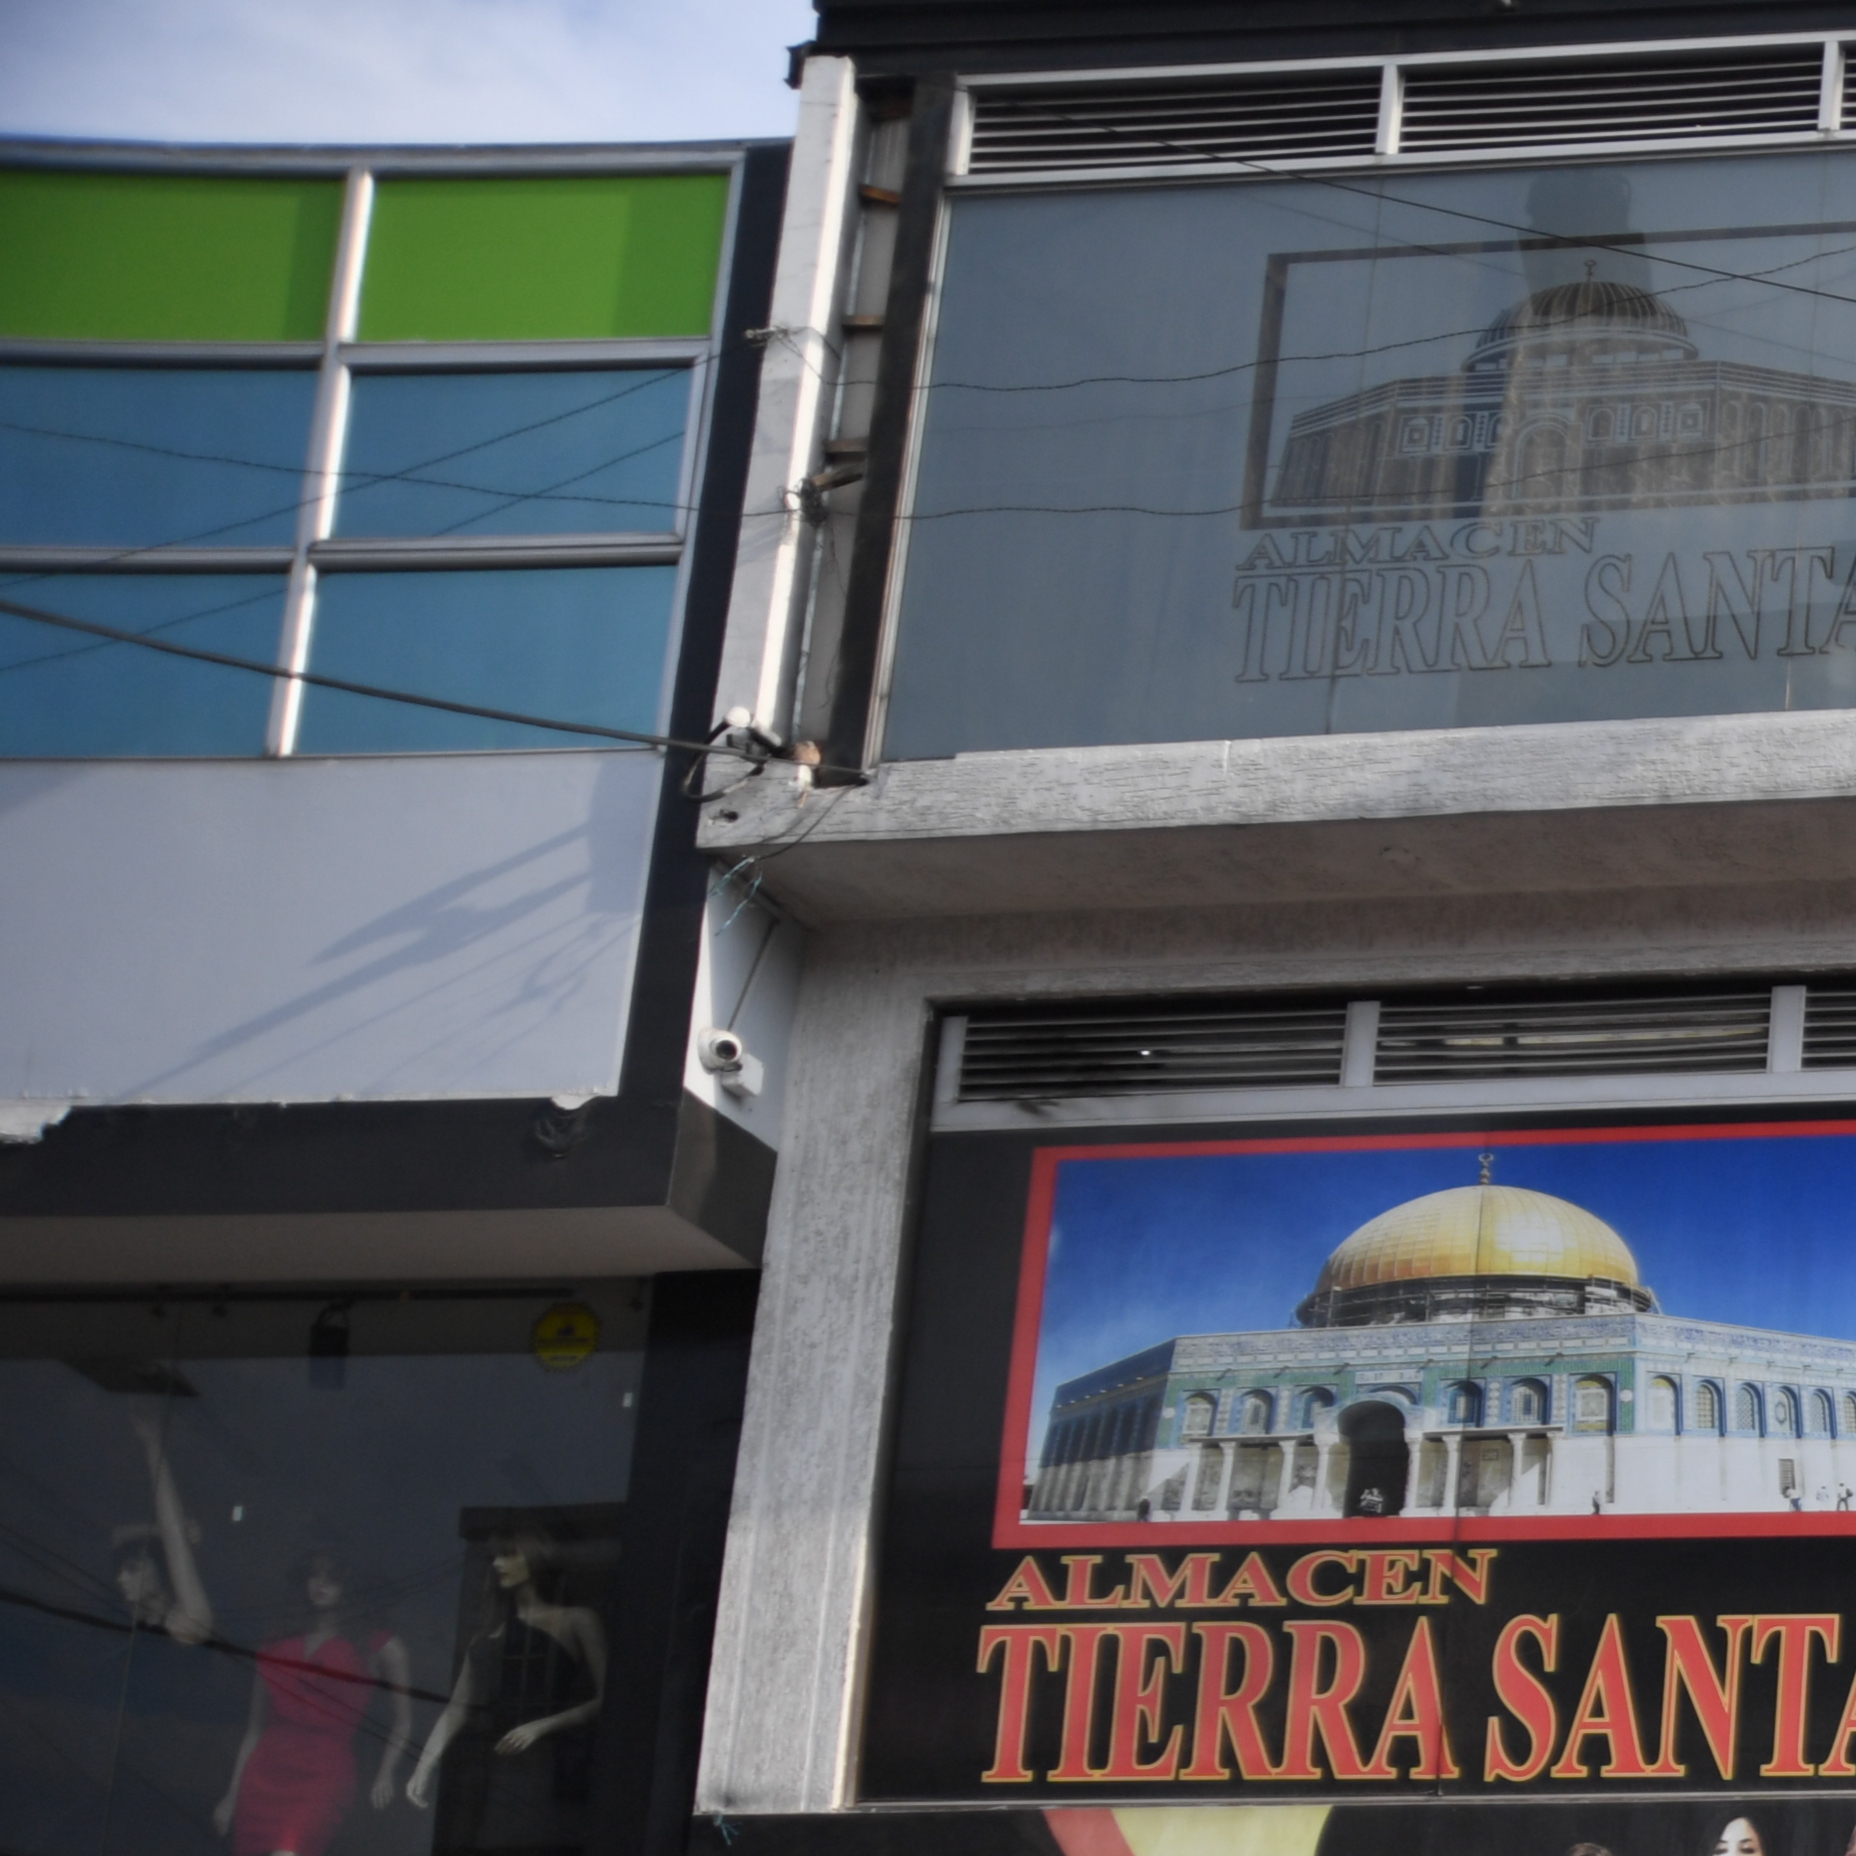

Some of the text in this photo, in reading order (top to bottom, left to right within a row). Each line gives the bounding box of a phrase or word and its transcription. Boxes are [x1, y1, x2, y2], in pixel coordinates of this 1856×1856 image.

[1236, 516, 1600, 572] ALMACEN
[1232, 556, 1552, 682] TIERRA
[985, 1548, 1498, 1611] ALMACEN
[976, 1614, 1459, 1784] TIERRA
